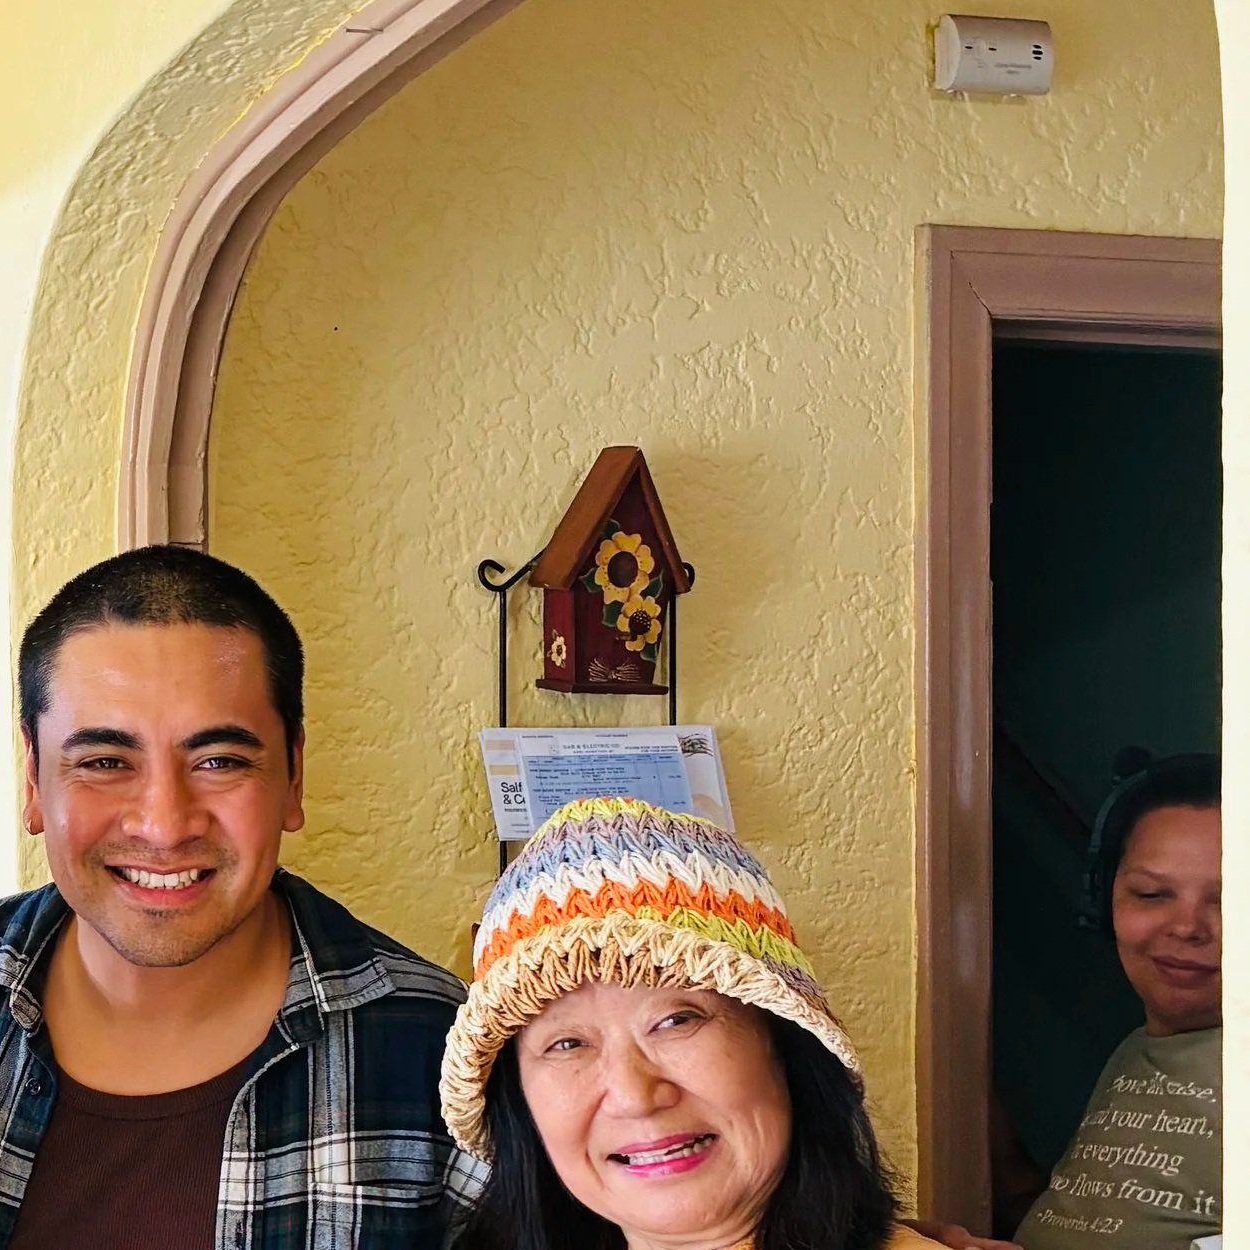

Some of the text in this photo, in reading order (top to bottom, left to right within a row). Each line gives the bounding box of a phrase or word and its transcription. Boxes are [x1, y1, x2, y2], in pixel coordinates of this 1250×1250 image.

[503, 794, 512, 805] &
[1152, 1108, 1214, 1138] heart,
[1082, 1142, 1185, 1177] everything
[1070, 1172, 1115, 1197] flows
[1117, 1178, 1183, 1211] from
[1191, 1189, 1216, 1216] it
